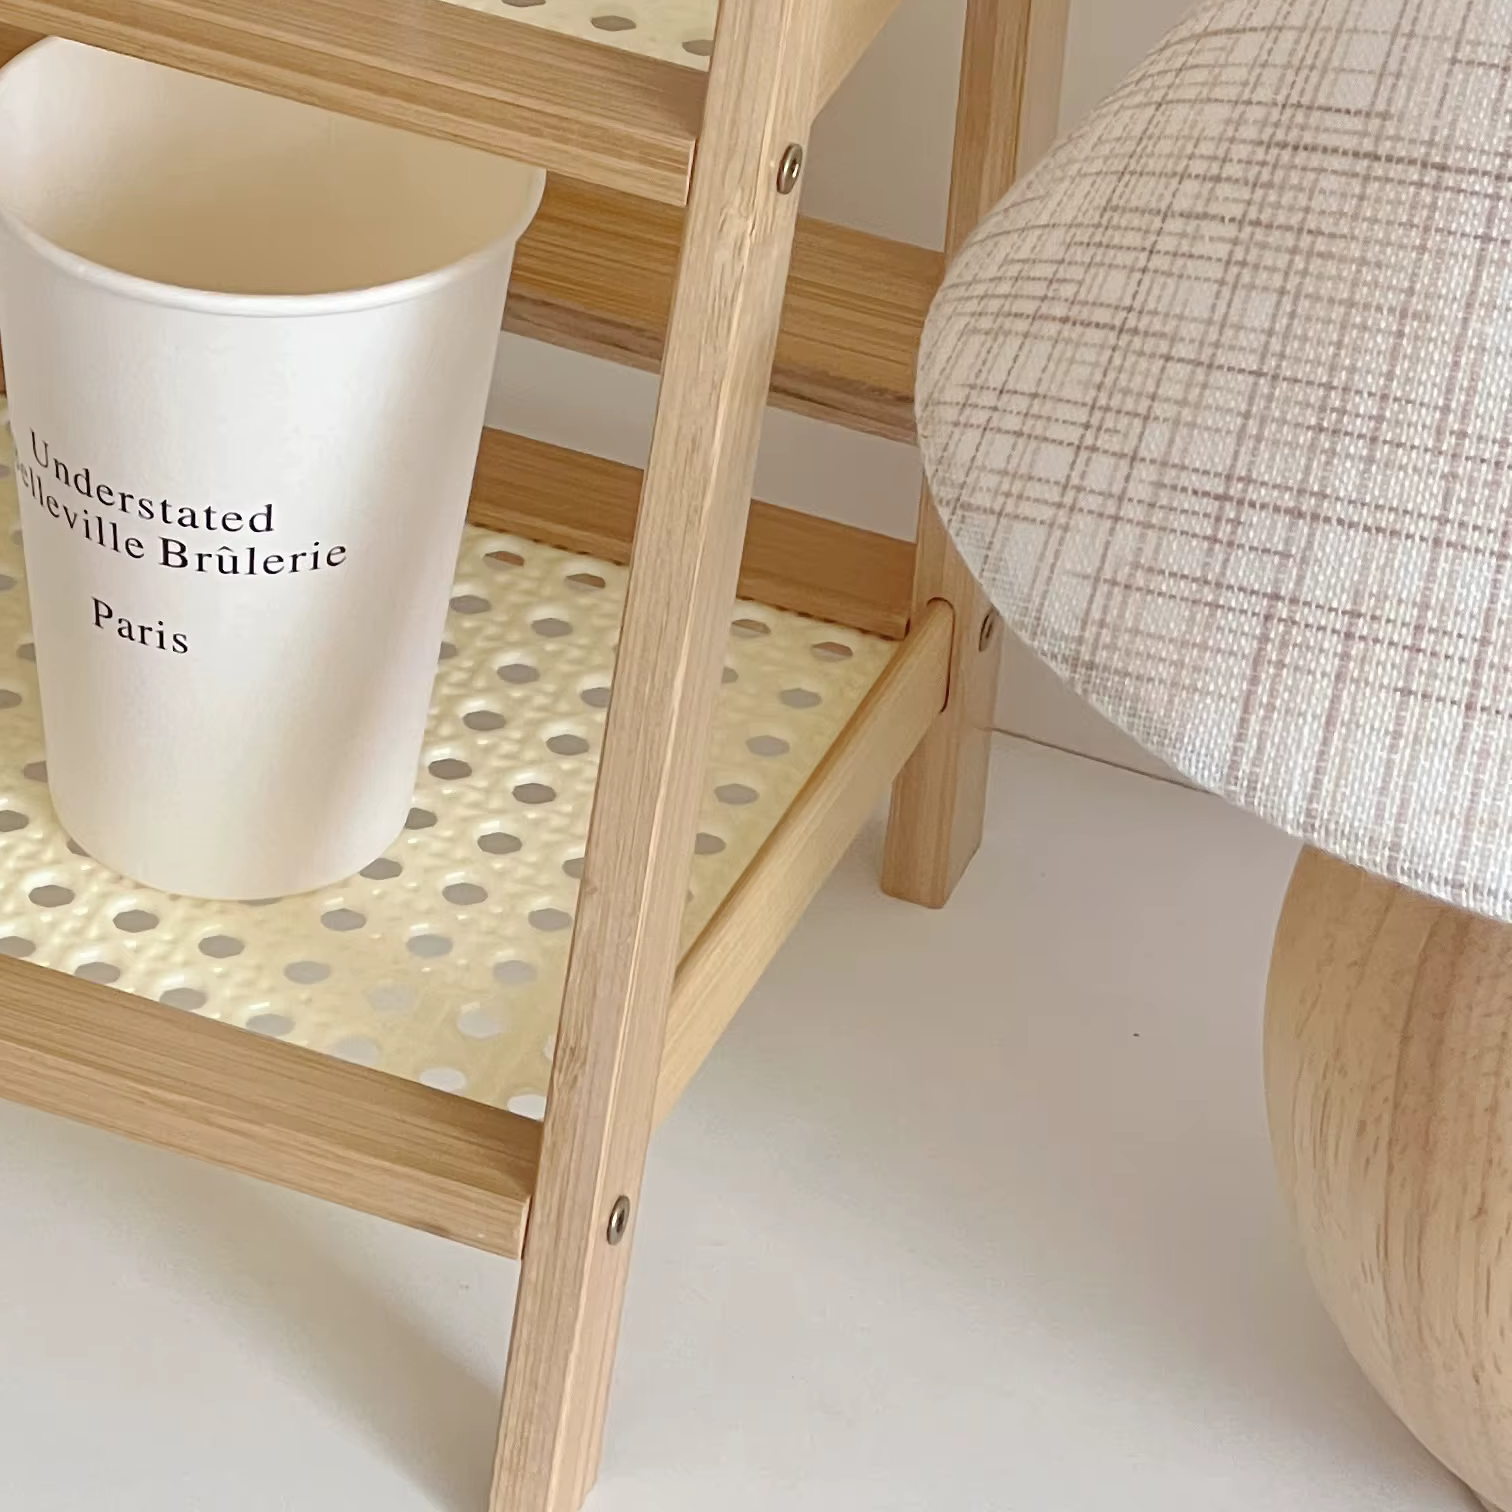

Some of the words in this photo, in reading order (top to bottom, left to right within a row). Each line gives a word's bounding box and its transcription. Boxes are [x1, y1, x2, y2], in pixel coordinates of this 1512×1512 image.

[14, 445, 145, 560] elleville
[158, 535, 348, 576] Brûlerie
[29, 426, 275, 533] Understated
[90, 595, 189, 656] Paris
